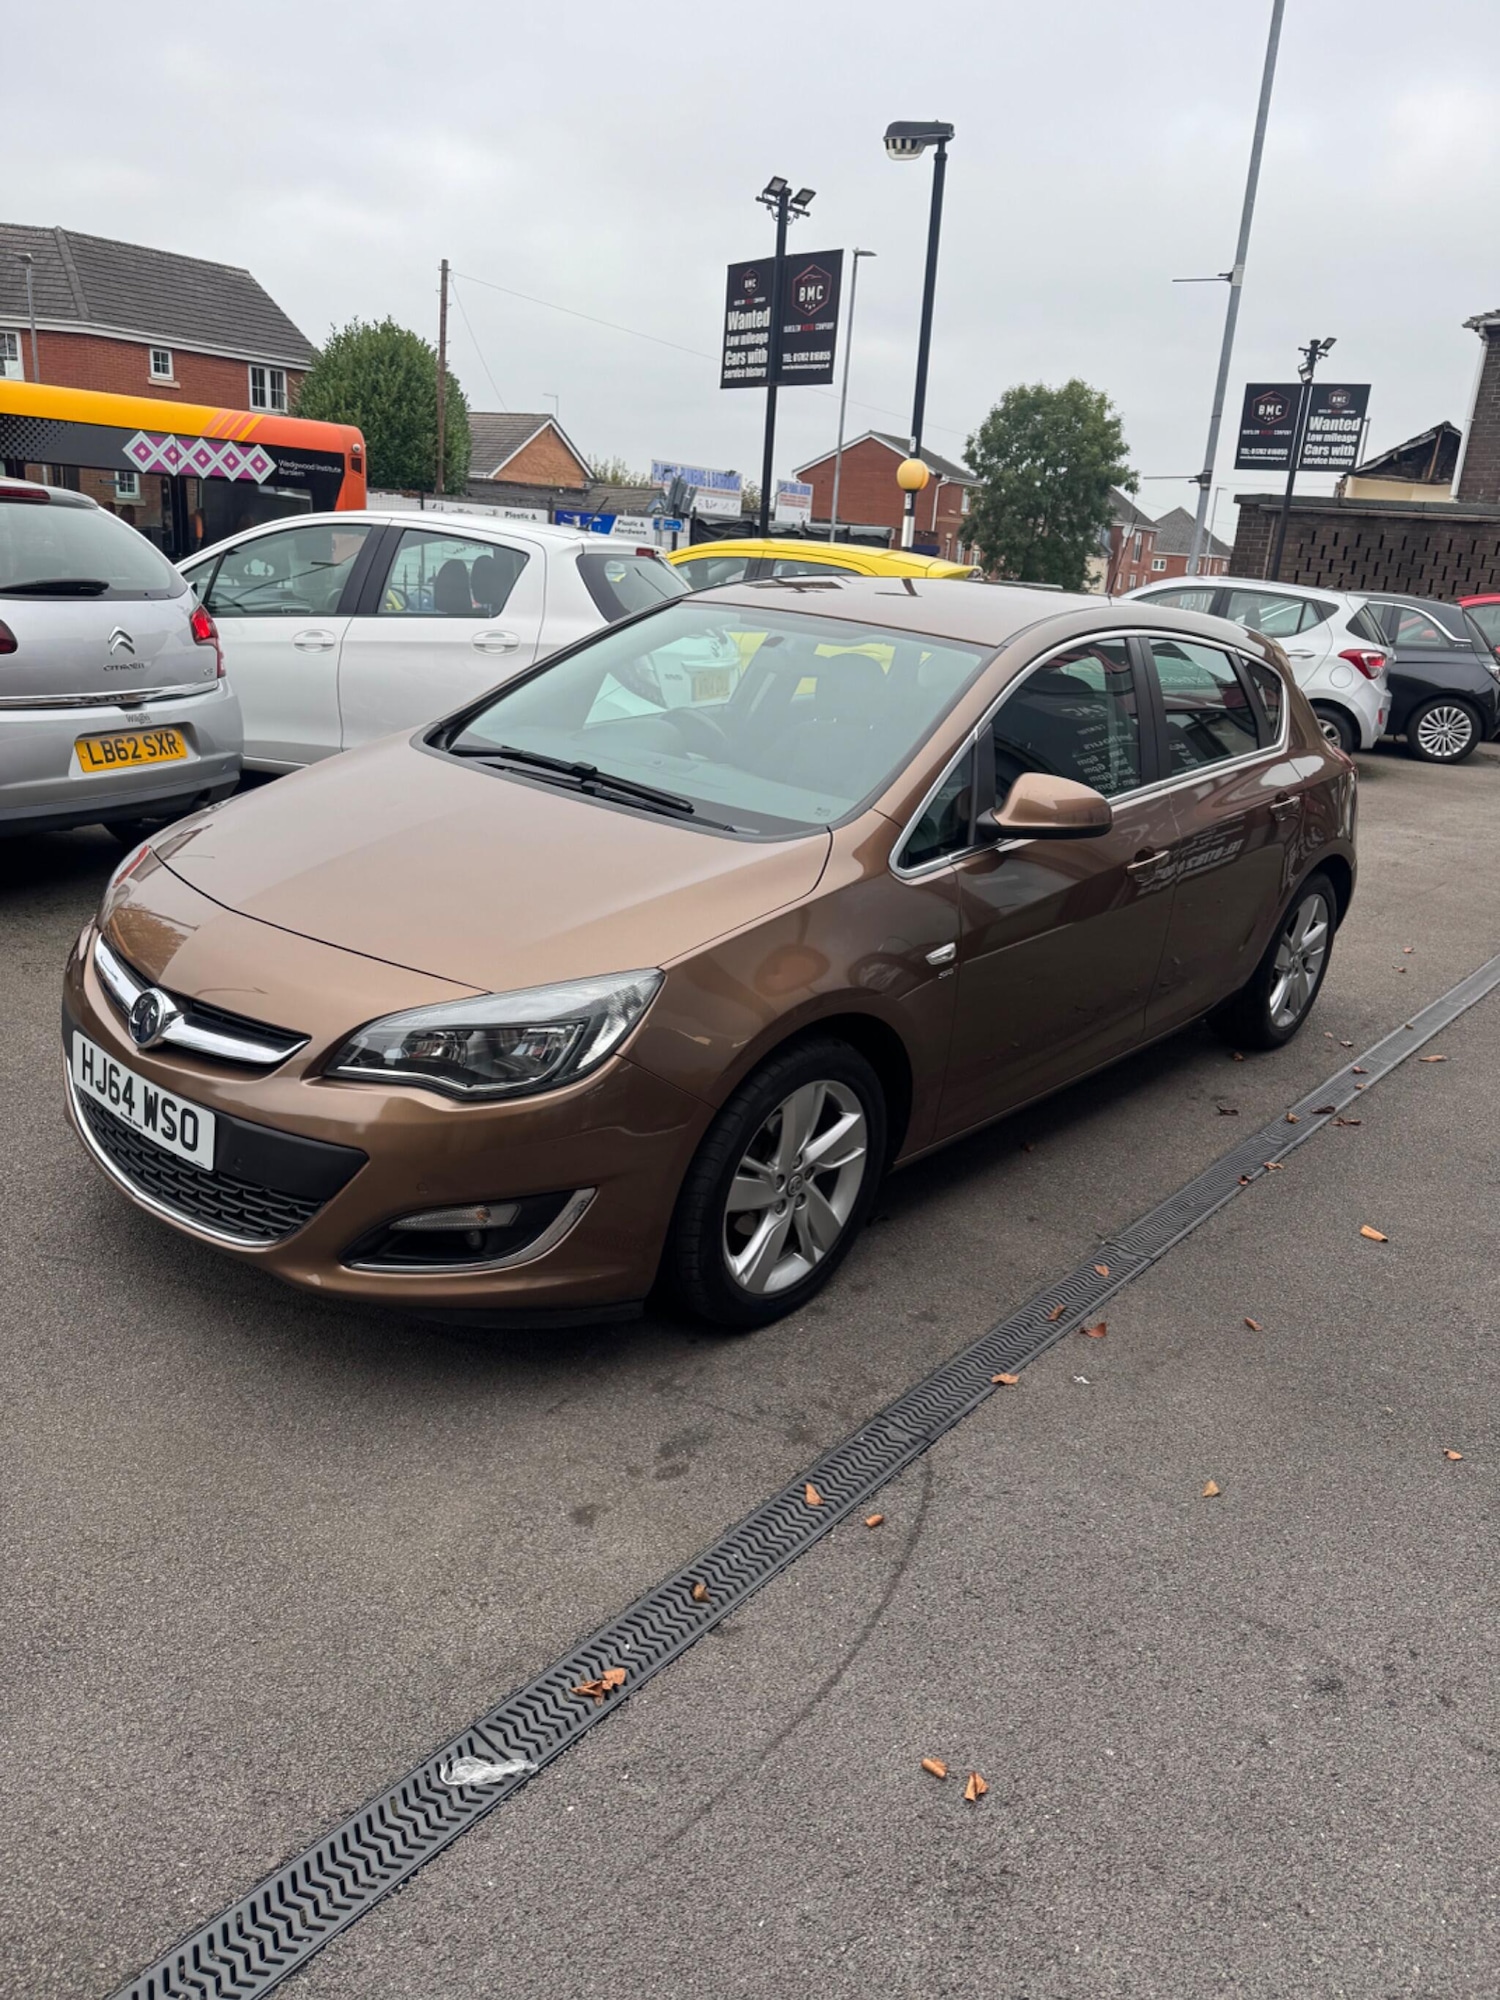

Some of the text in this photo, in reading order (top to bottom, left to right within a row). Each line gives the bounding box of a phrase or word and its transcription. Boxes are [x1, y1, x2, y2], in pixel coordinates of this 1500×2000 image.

[799, 285, 824, 303] BMC
[727, 307, 771, 331] Wanted
[726, 332, 769, 347] Low mileage
[725, 347, 768, 366] Cars with
[723, 366, 767, 379] service history
[1258, 404, 1283, 416] BMC
[1308, 416, 1362, 431] Wanted
[1306, 432, 1358, 443] Low mileage
[1304, 444, 1356, 457] Cars with
[278, 459, 342, 473] Wedgwood Institute
[1302, 457, 1354, 466] service history
[505, 511, 537, 521] Plastic &
[617, 519, 639, 528] Plastic
[614, 527, 647, 536] Hardware
[86, 731, 180, 766] LB62 SXR
[82, 1042, 200, 1152] HJ64 WSO
